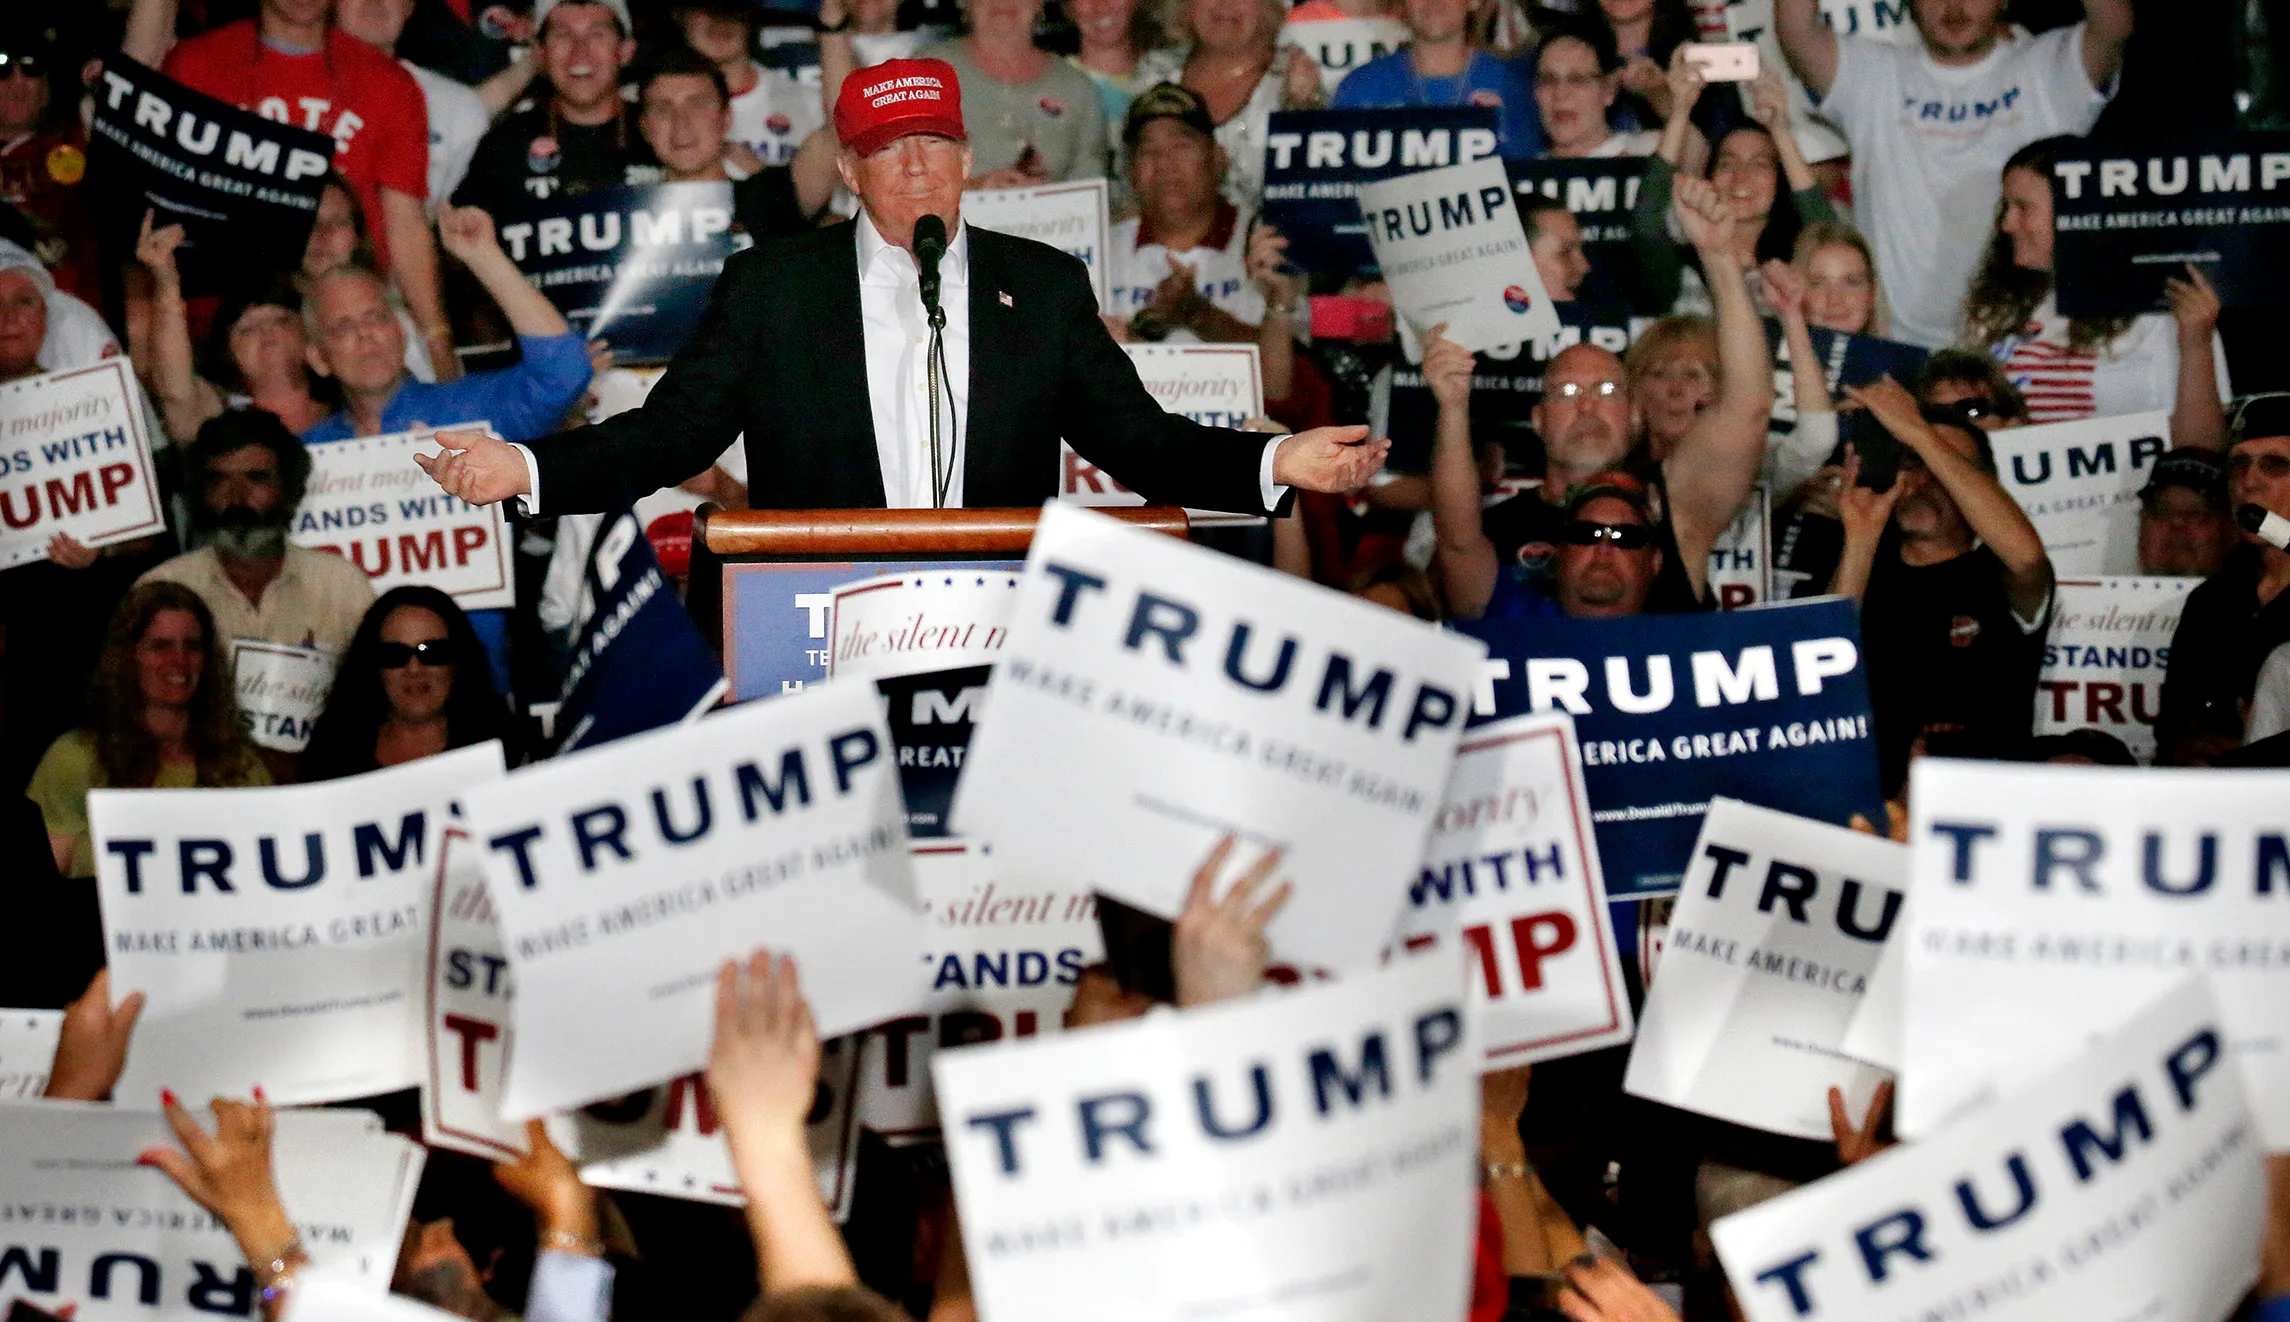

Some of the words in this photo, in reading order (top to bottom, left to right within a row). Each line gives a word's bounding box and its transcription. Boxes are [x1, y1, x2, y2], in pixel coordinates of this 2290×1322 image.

[863, 80, 894, 98] MAKE
[895, 77, 943, 88] AMERICA
[872, 91, 907, 108] GREAT
[908, 90, 940, 100] AGAIN
[103, 69, 329, 181] TRUMP
[1269, 128, 1496, 169] TRUMP
[131, 139, 196, 182] AMERICA
[2053, 153, 2290, 199] TRUMP
[502, 207, 733, 261] TRUMP
[1365, 186, 1506, 247] TRUMP
[2105, 210, 2179, 229] AMERICA
[40, 425, 128, 464] WITH
[2011, 436, 2166, 486] UMP
[0, 462, 136, 529] UMP
[300, 502, 388, 533] ANDS
[840, 620, 878, 660] the
[880, 613, 976, 653] silent
[2083, 602, 2156, 632] silent
[1042, 560, 1457, 744] TRUMP
[1470, 636, 1858, 717] TRUMP
[2041, 645, 2170, 670] STANDS
[900, 745, 967, 768] REAT
[1580, 737, 1666, 767] ERICA
[1671, 728, 1761, 761] GREAT
[1768, 714, 1868, 751] AGAIN!
[489, 727, 880, 890] TRUMP
[106, 804, 461, 895] TRUM
[1409, 842, 1566, 905] WITH
[938, 882, 1056, 927] silent
[1704, 843, 1905, 943] TRU
[114, 929, 181, 955] MAKE
[189, 923, 321, 953] AMERICA
[328, 905, 420, 943] GREAT
[923, 948, 1086, 990] ANDS
[1673, 927, 1740, 965] MAKE
[1747, 949, 1869, 997] AMERICA
[964, 1004, 1464, 1177] TRUMP
[1755, 1025, 2222, 1317] TRUMP
[0, 1245, 257, 1317] RUM
